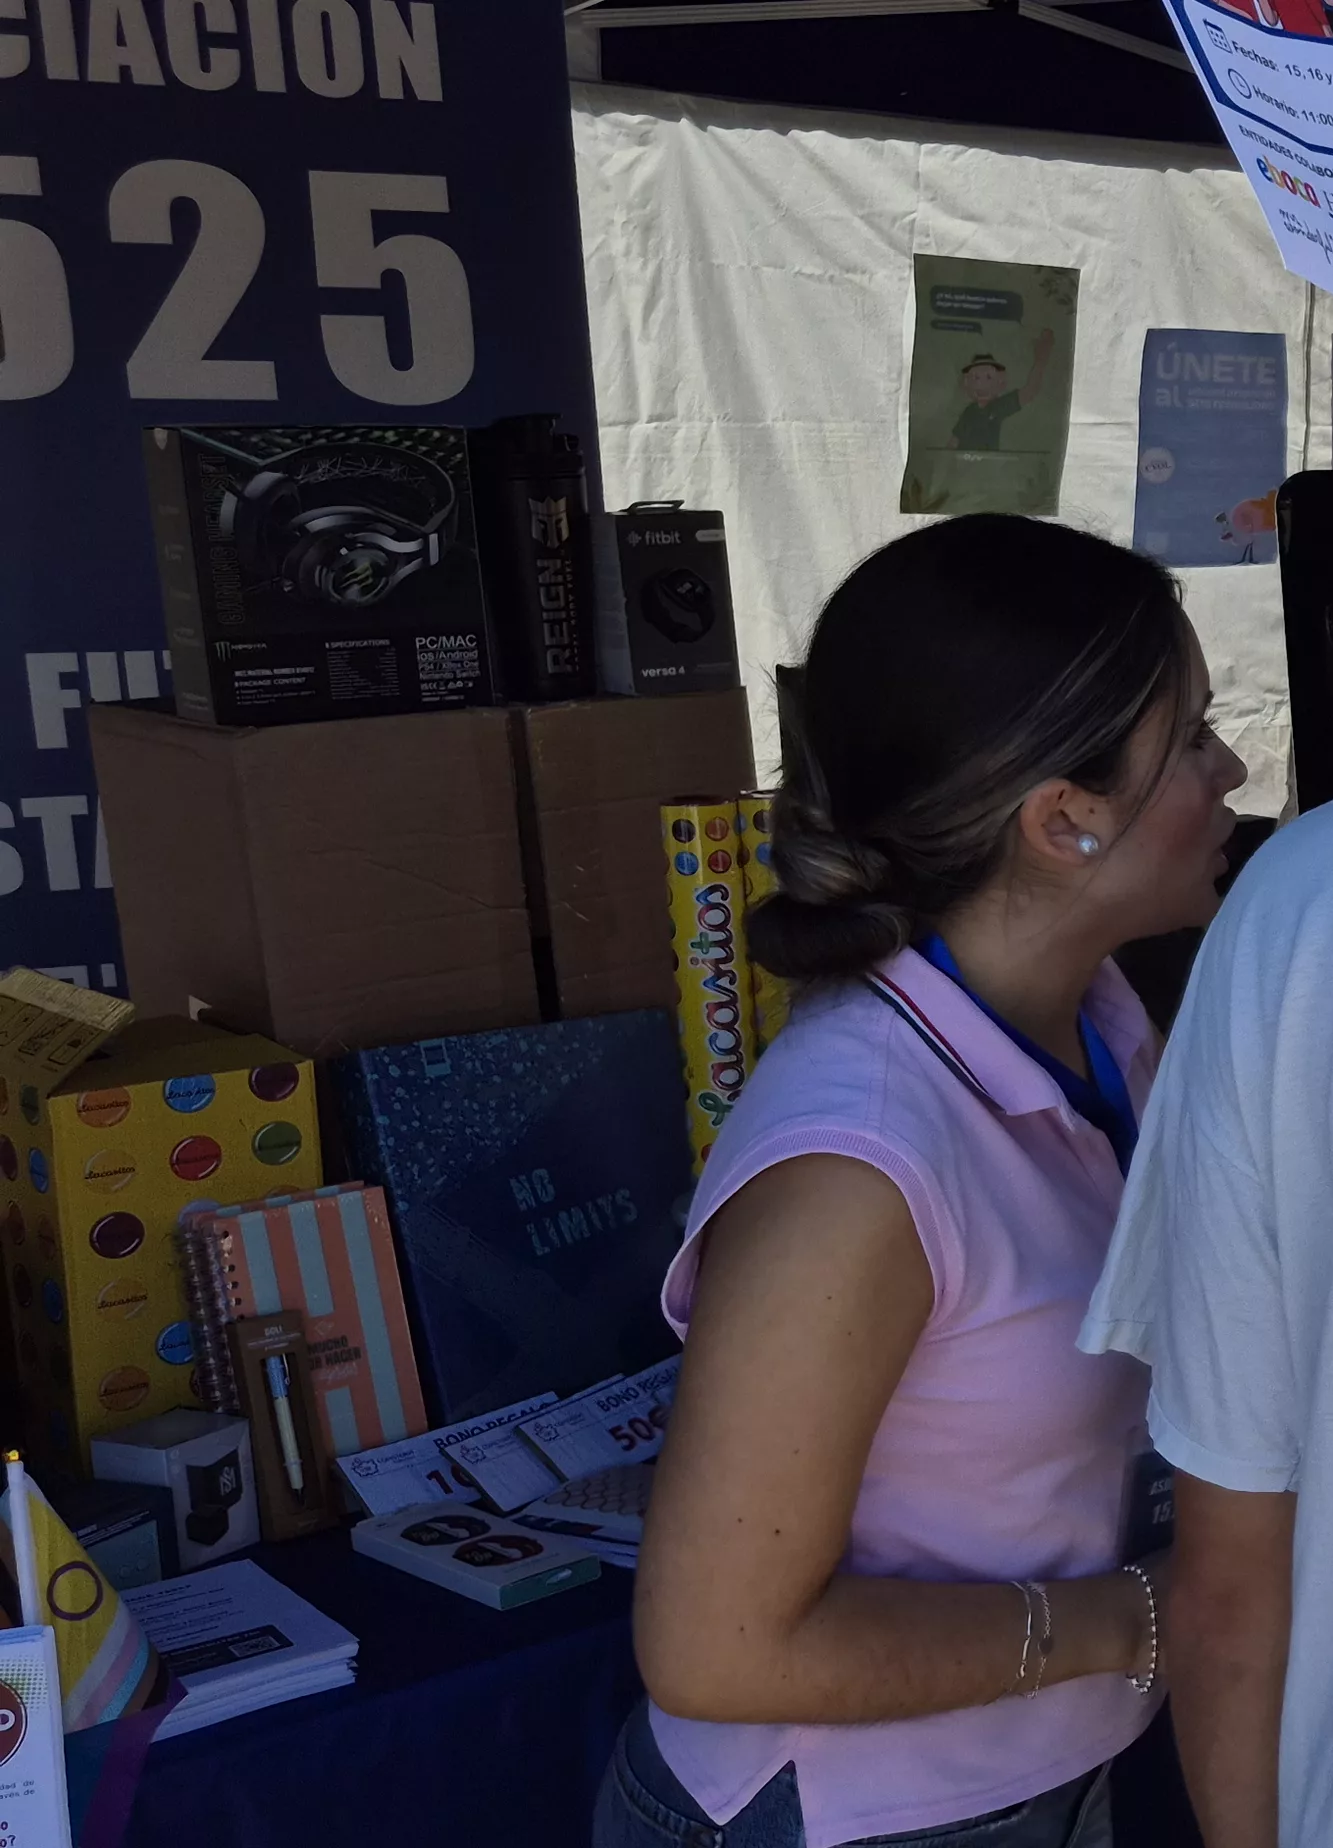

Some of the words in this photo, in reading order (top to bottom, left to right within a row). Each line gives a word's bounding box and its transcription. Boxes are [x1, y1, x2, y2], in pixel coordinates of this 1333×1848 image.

[1231, 40, 1280, 73] Fechas:
[1284, 63, 1307, 80] 15,
[1307, 67, 1324, 81] 16
[1326, 72, 1333, 85] y
[1252, 85, 1300, 119] Horario:
[1239, 125, 1294, 161] ENTIDADES
[1156, 341, 1276, 385] ÚNETE
[1155, 386, 1183, 409] al
[645, 531, 681, 546] fitbit
[535, 557, 573, 675] REIGN
[415, 634, 478, 650] PC/MAC
[641, 664, 677, 678] versa
[677, 665, 686, 676] 4
[509, 1168, 557, 1212] NO
[596, 1384, 640, 1414] BONO
